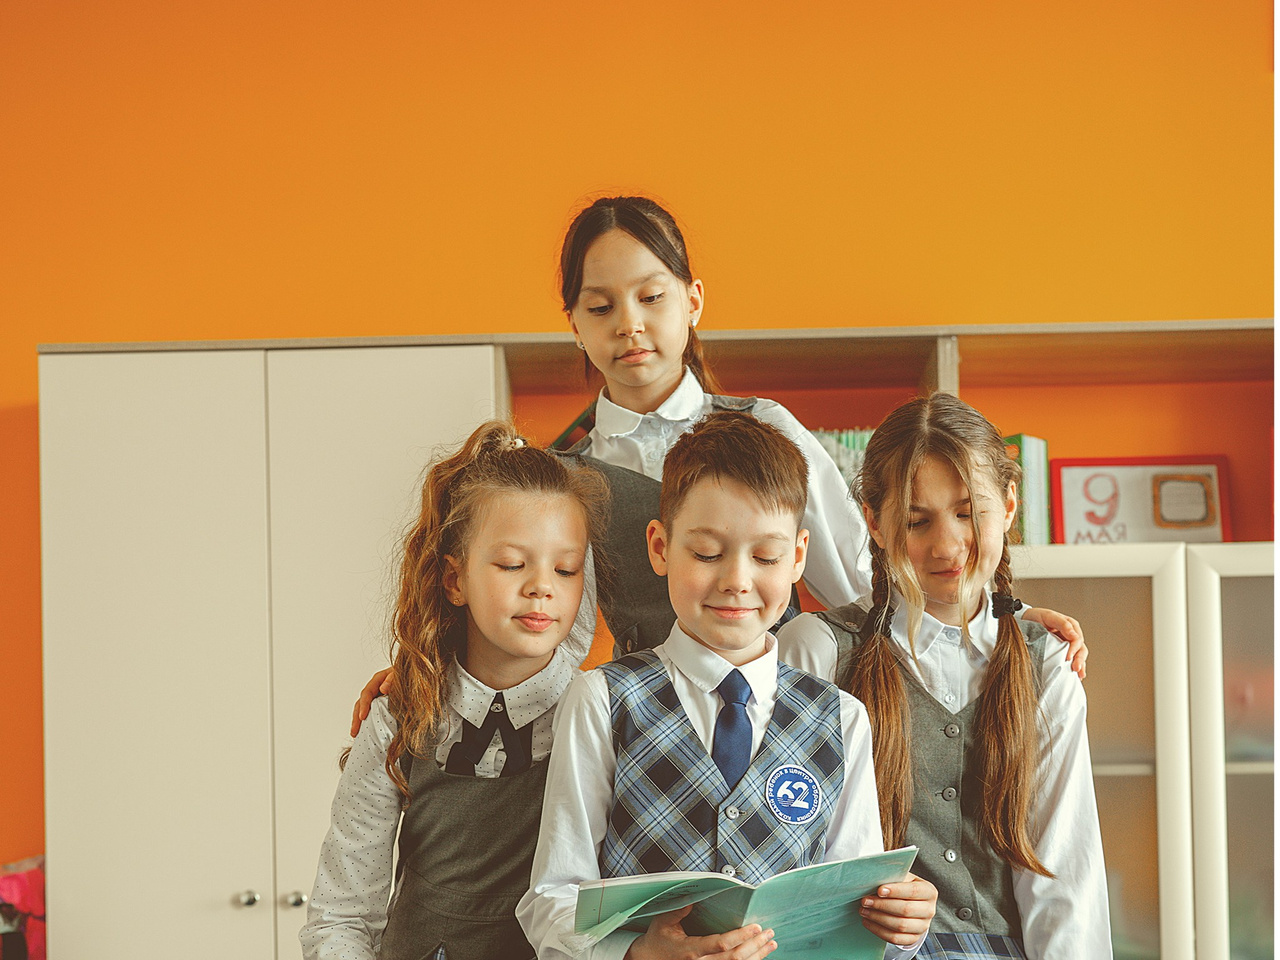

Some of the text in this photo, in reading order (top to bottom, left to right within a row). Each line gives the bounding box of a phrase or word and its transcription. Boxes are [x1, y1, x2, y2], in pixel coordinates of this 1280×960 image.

[1083, 473, 1119, 526] 9
[1074, 523, 1127, 545] МАЯ
[777, 780, 809, 809] 62
